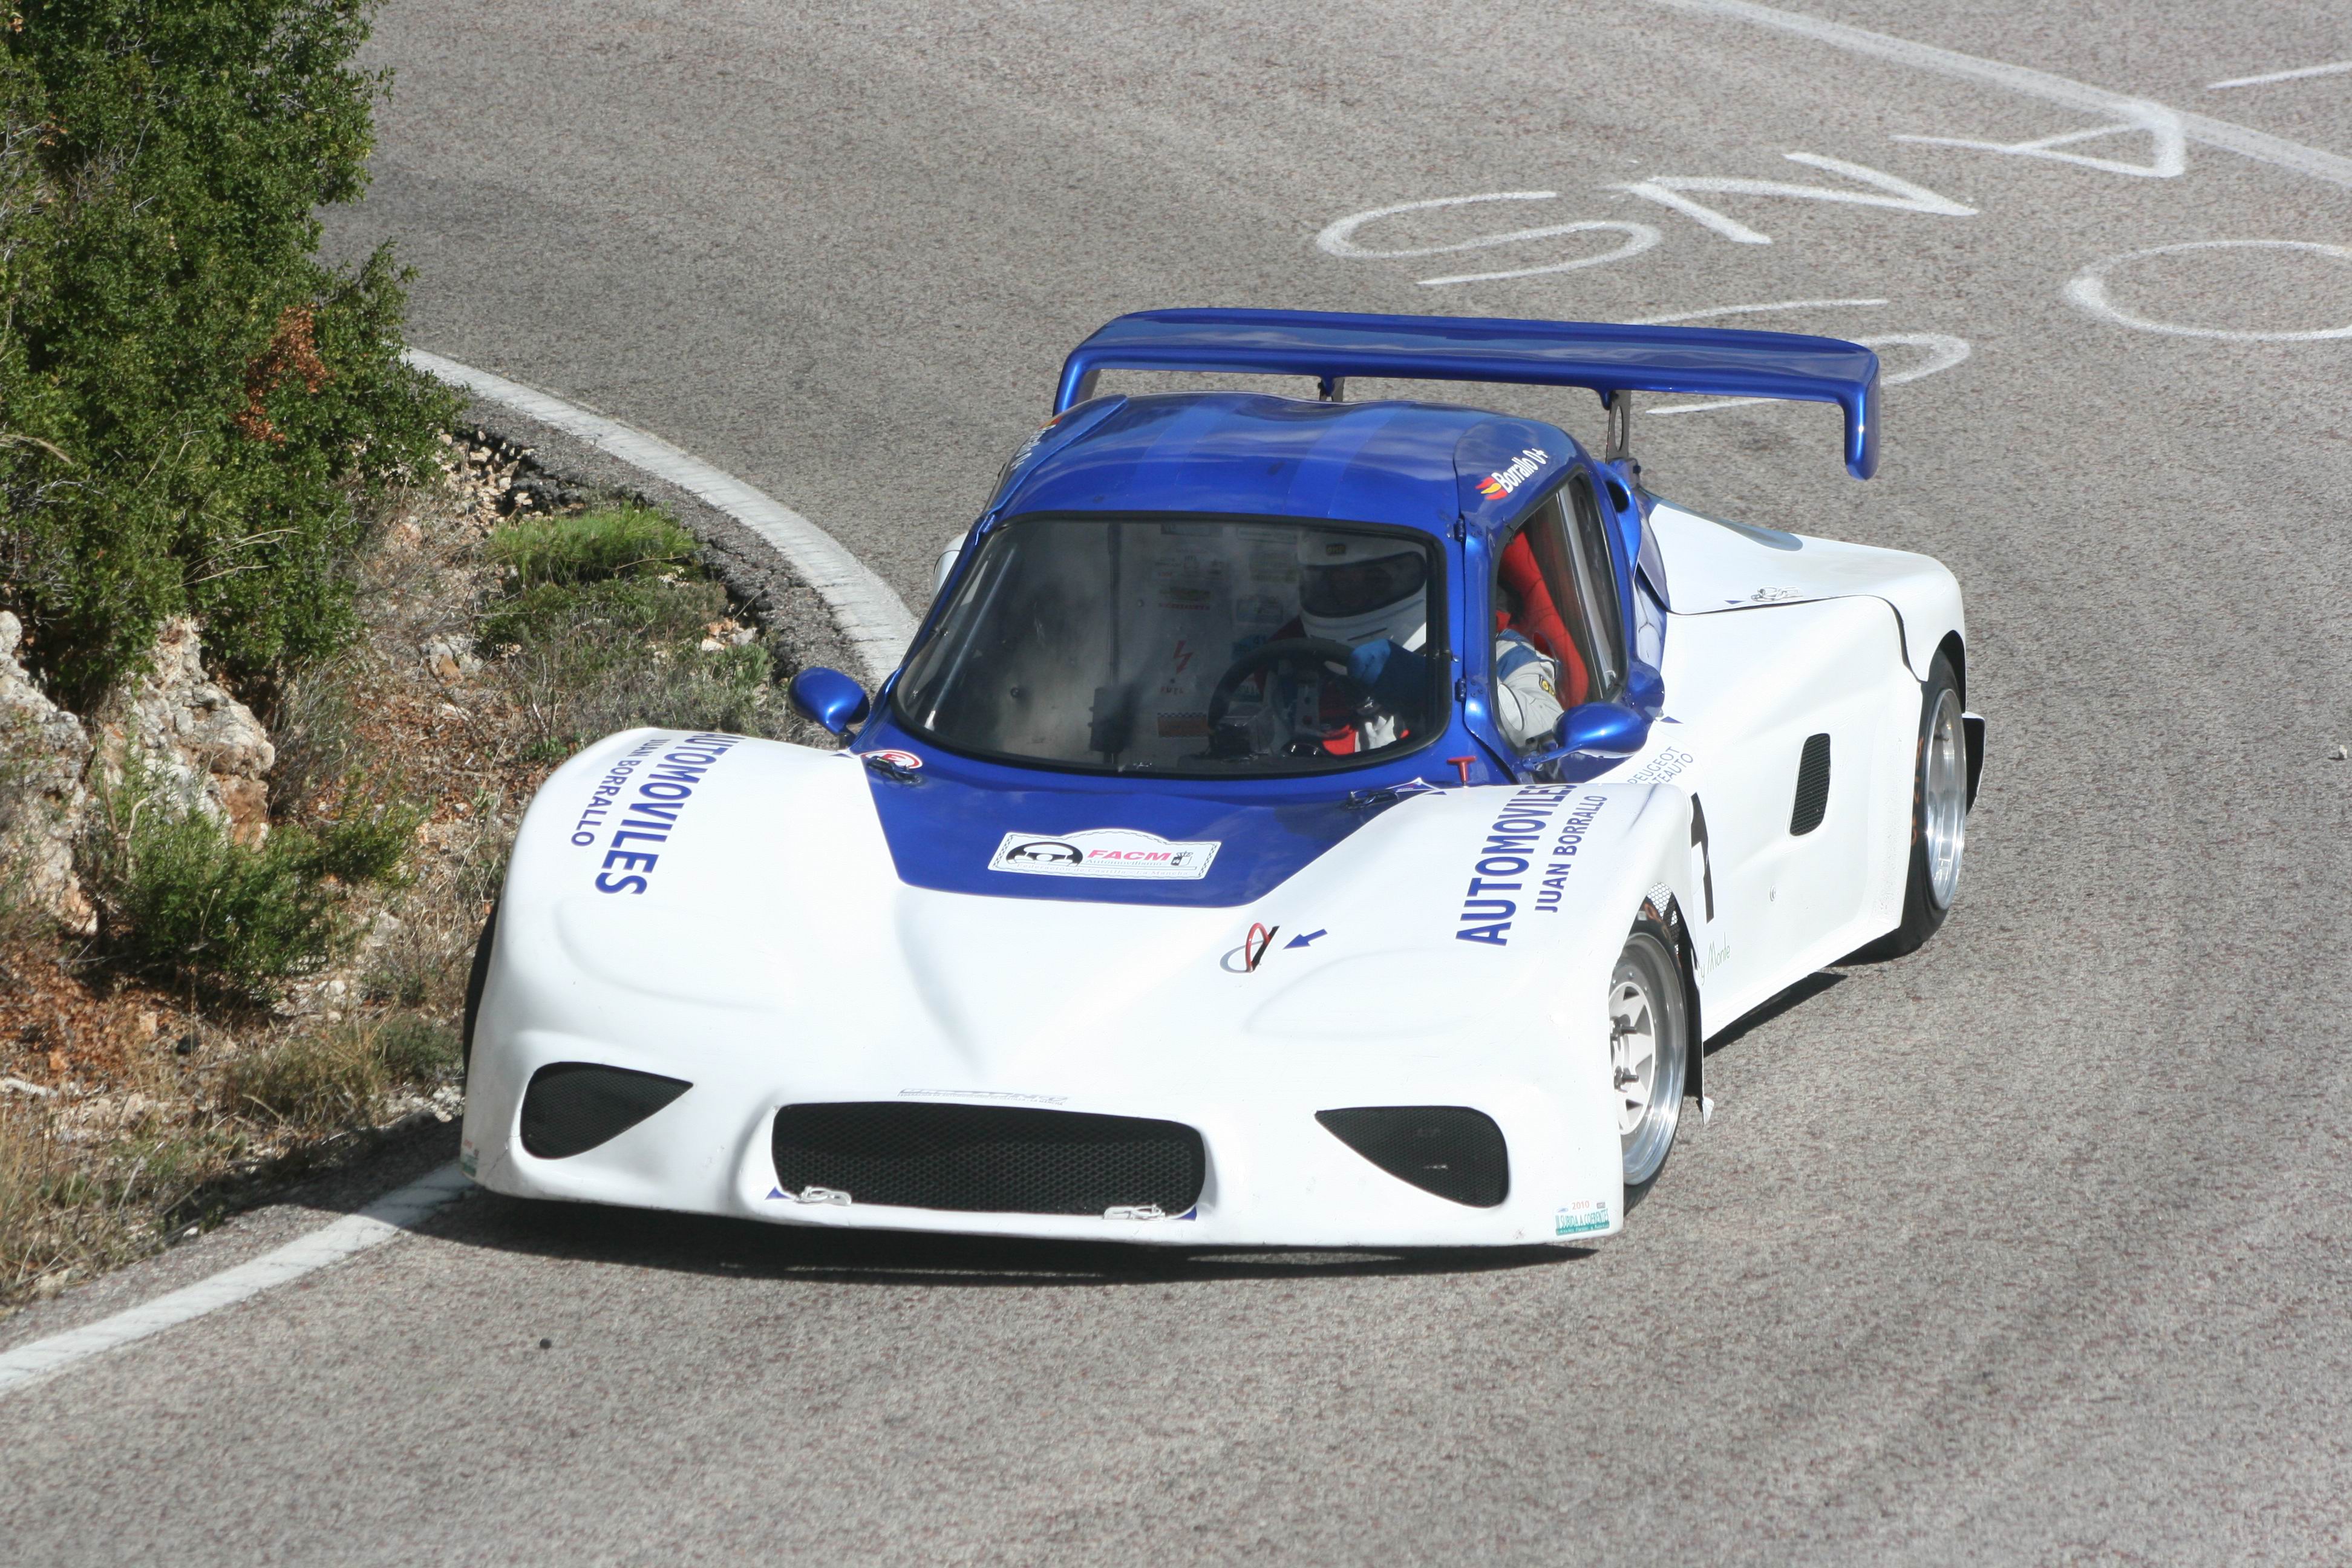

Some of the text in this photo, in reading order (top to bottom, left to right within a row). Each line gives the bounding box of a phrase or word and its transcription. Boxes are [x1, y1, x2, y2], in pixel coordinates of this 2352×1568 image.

[1491, 457, 1538, 494] Borrallo
[570, 739, 671, 847] JUAN BORRALLO
[1648, 753, 1693, 784] TEAUTO
[595, 733, 746, 895] AUTOMOVILES
[1087, 849, 1172, 861] FACM
[1455, 785, 1578, 947] AUTOMOVILES
[1534, 795, 1608, 913] JUAN BORRALLO
[1572, 1200, 1590, 1210] 2010
